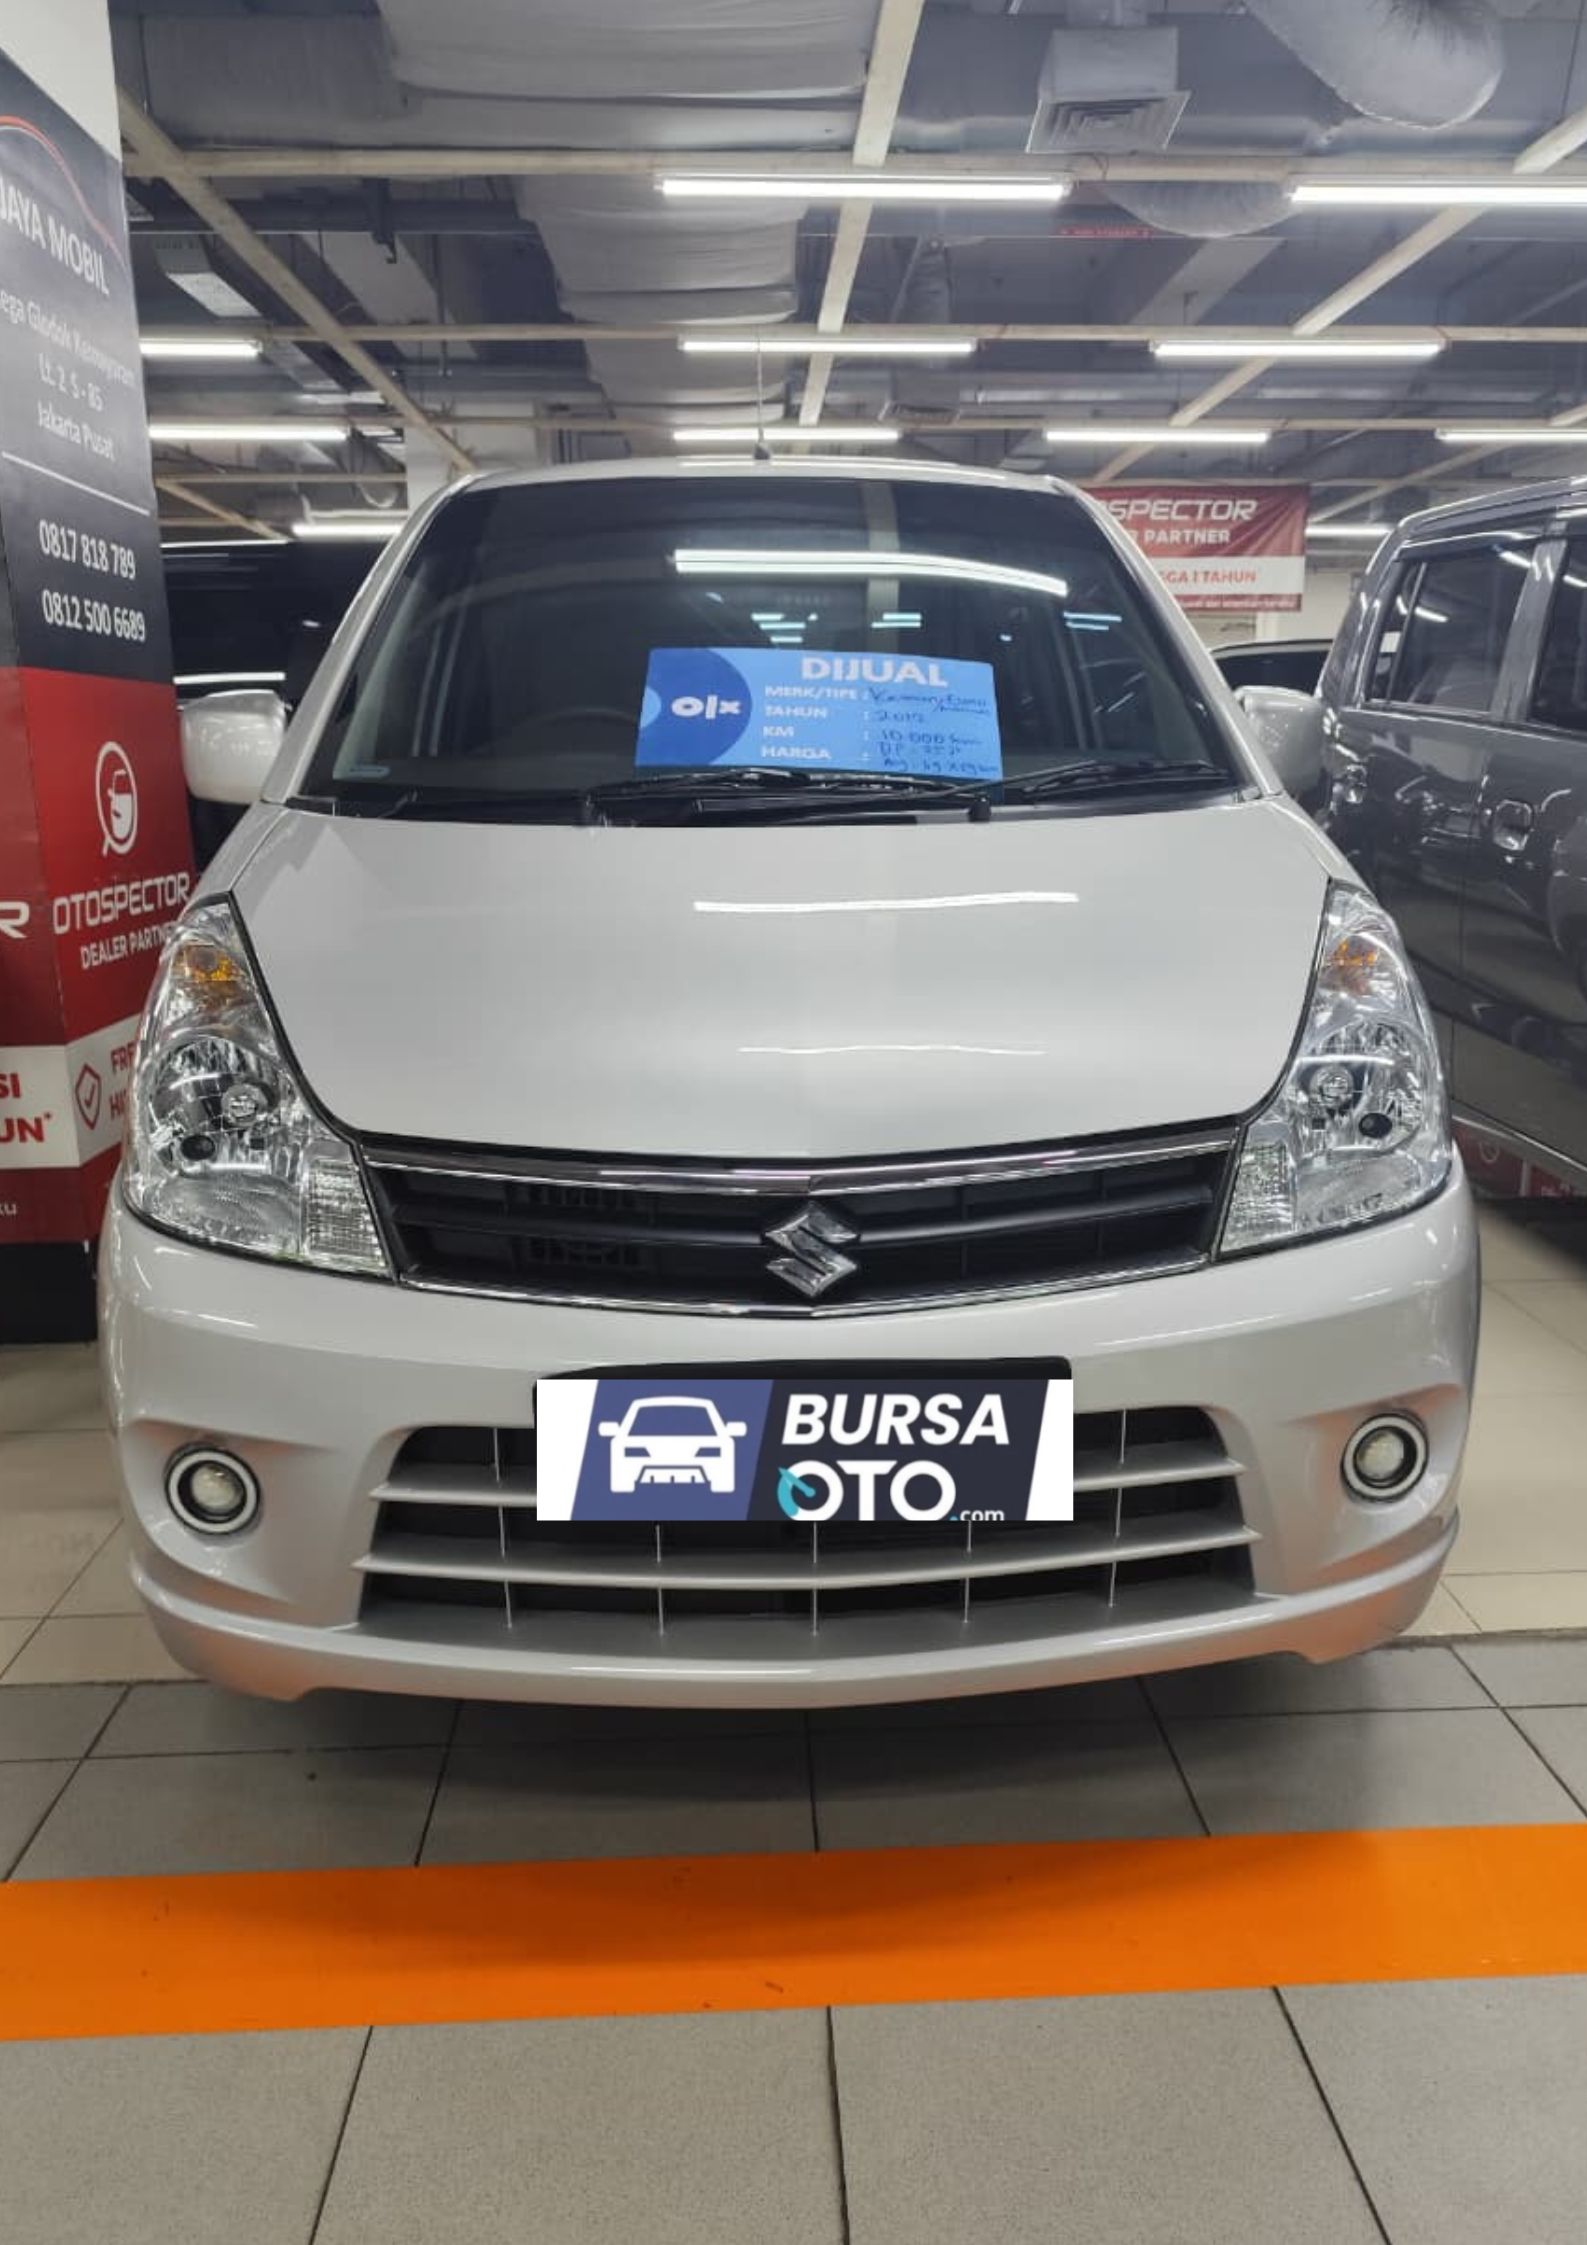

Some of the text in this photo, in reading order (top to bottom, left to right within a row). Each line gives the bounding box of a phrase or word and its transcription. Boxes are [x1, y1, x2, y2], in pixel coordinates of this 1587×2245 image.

[49, 215, 109, 296] MOBIL
[1144, 528, 1231, 545] PARTNER
[39, 519, 136, 580] 0817 818 789
[1203, 570, 1257, 584] TAHUN
[42, 589, 146, 642] 0812 500 6689
[801, 656, 949, 688] DIJUAL
[764, 686, 858, 700] MERK/TIPE
[671, 695, 741, 719] olx
[765, 705, 828, 719] TAHUN
[762, 725, 795, 738] KM
[761, 746, 832, 760] HARGA
[53, 872, 191, 935] OTOSPECTOR
[80, 935, 128, 970] DEALER
